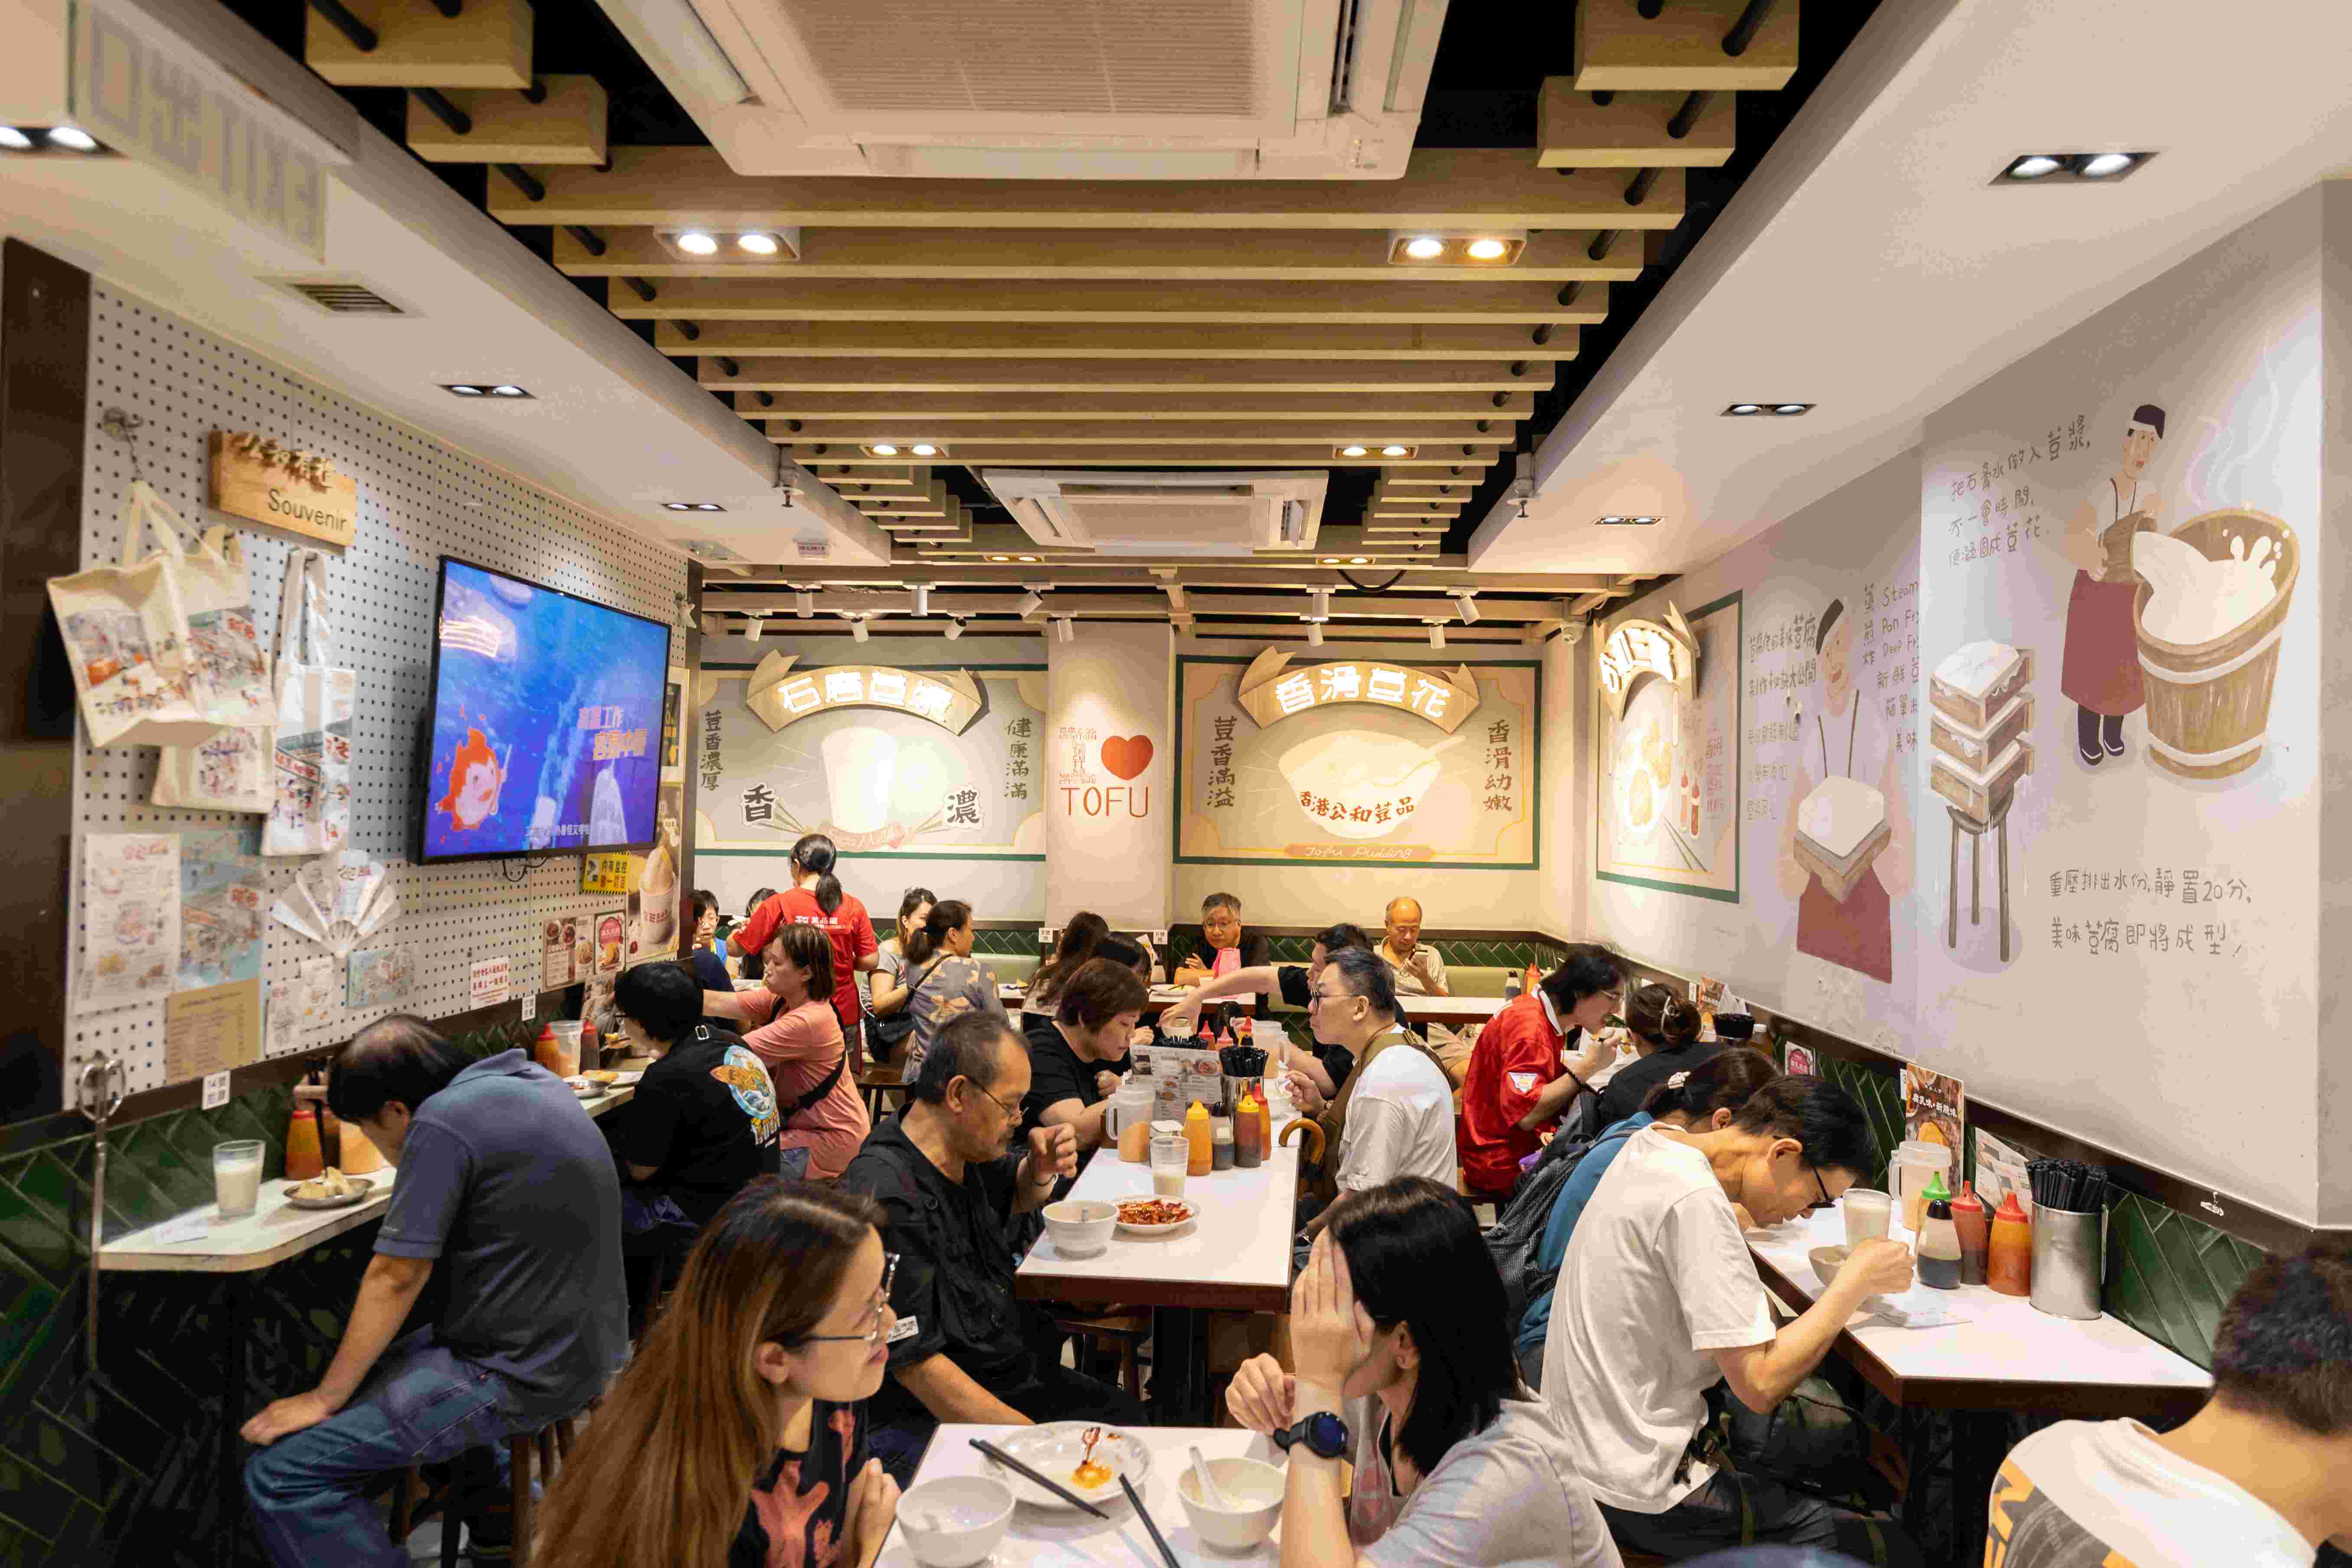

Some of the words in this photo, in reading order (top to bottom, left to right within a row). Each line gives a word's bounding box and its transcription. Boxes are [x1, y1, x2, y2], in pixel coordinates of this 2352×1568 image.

[268, 488, 347, 531] Souvenir
[1882, 581, 1918, 607] Steam
[1882, 617, 1899, 634] Pan
[743, 785, 775, 822] 香
[947, 789, 980, 824] 濃
[1060, 786, 1149, 818] TOFU
[1304, 846, 1343, 859] Tofu
[1350, 846, 1413, 860] Pudding
